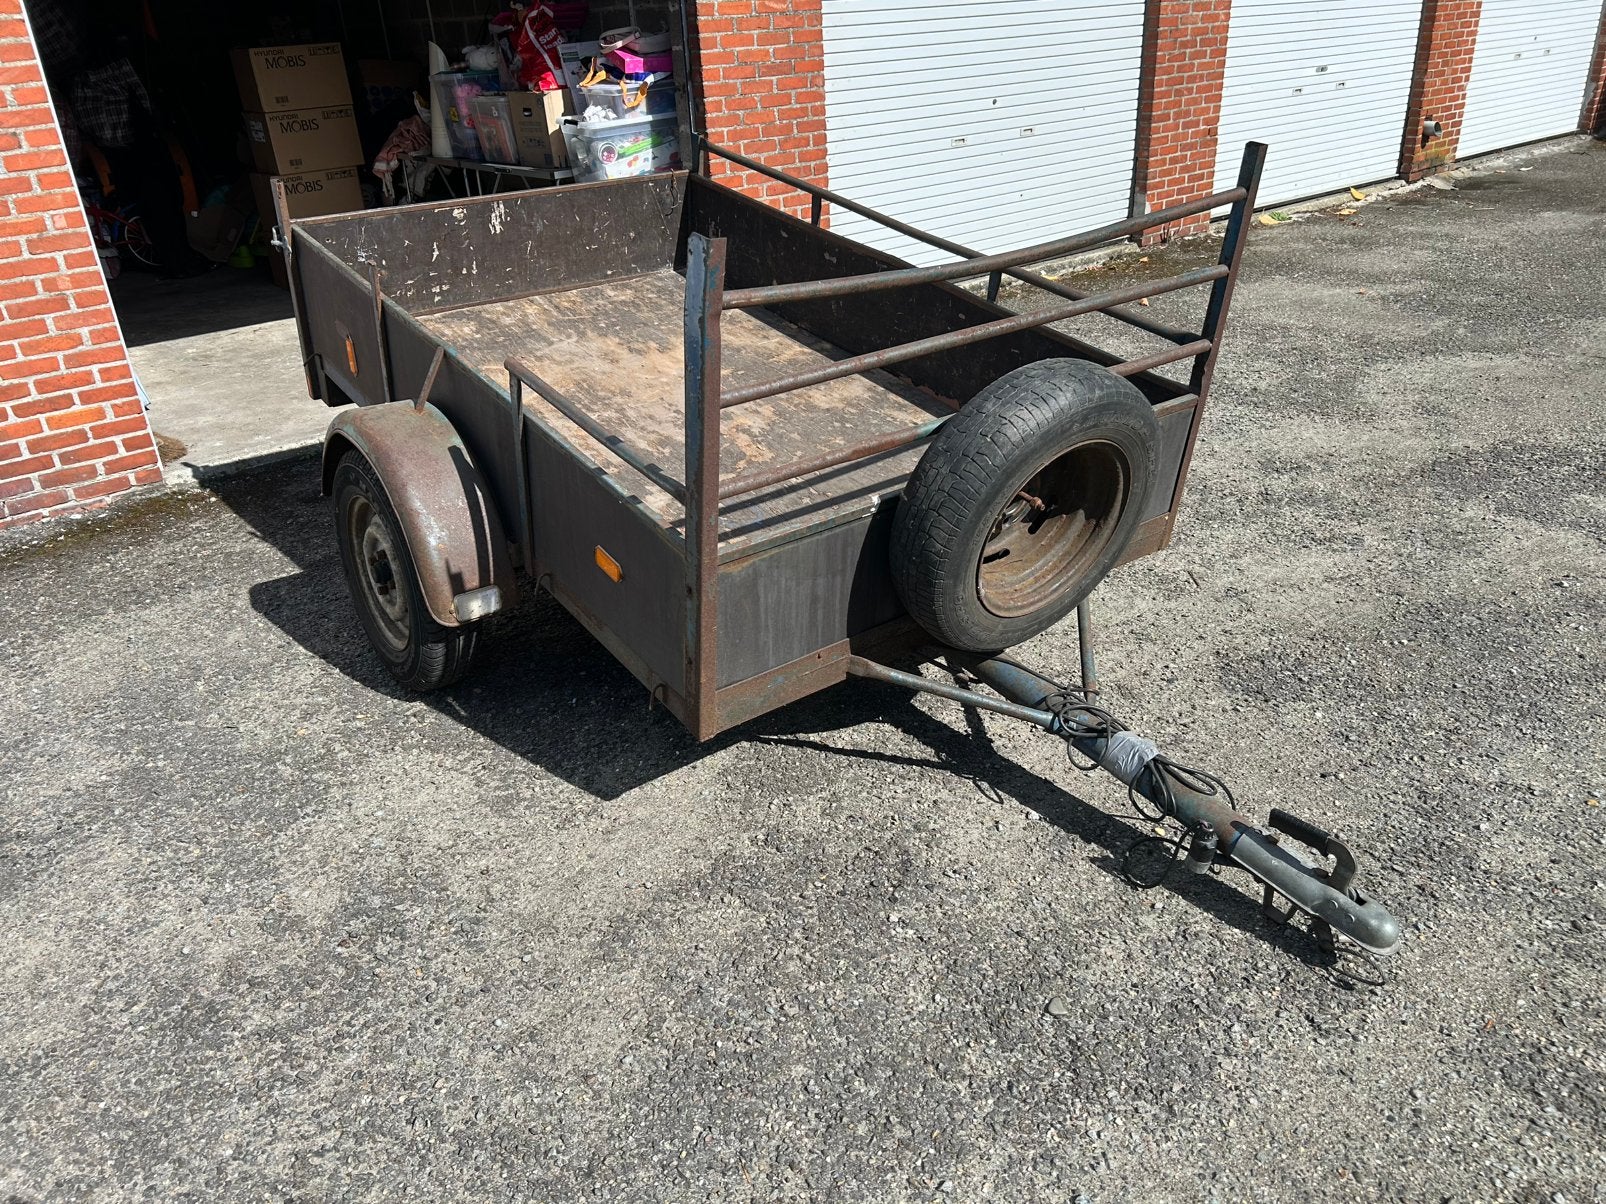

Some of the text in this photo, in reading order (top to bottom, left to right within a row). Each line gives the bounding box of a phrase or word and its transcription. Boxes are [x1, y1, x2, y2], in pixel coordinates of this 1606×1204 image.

[254, 49, 284, 57] HYUNDAI
[265, 54, 306, 69] MOBIS
[270, 114, 299, 122] HYUNDAI
[280, 118, 319, 133] MOBIS
[285, 179, 323, 195] MOBIS
